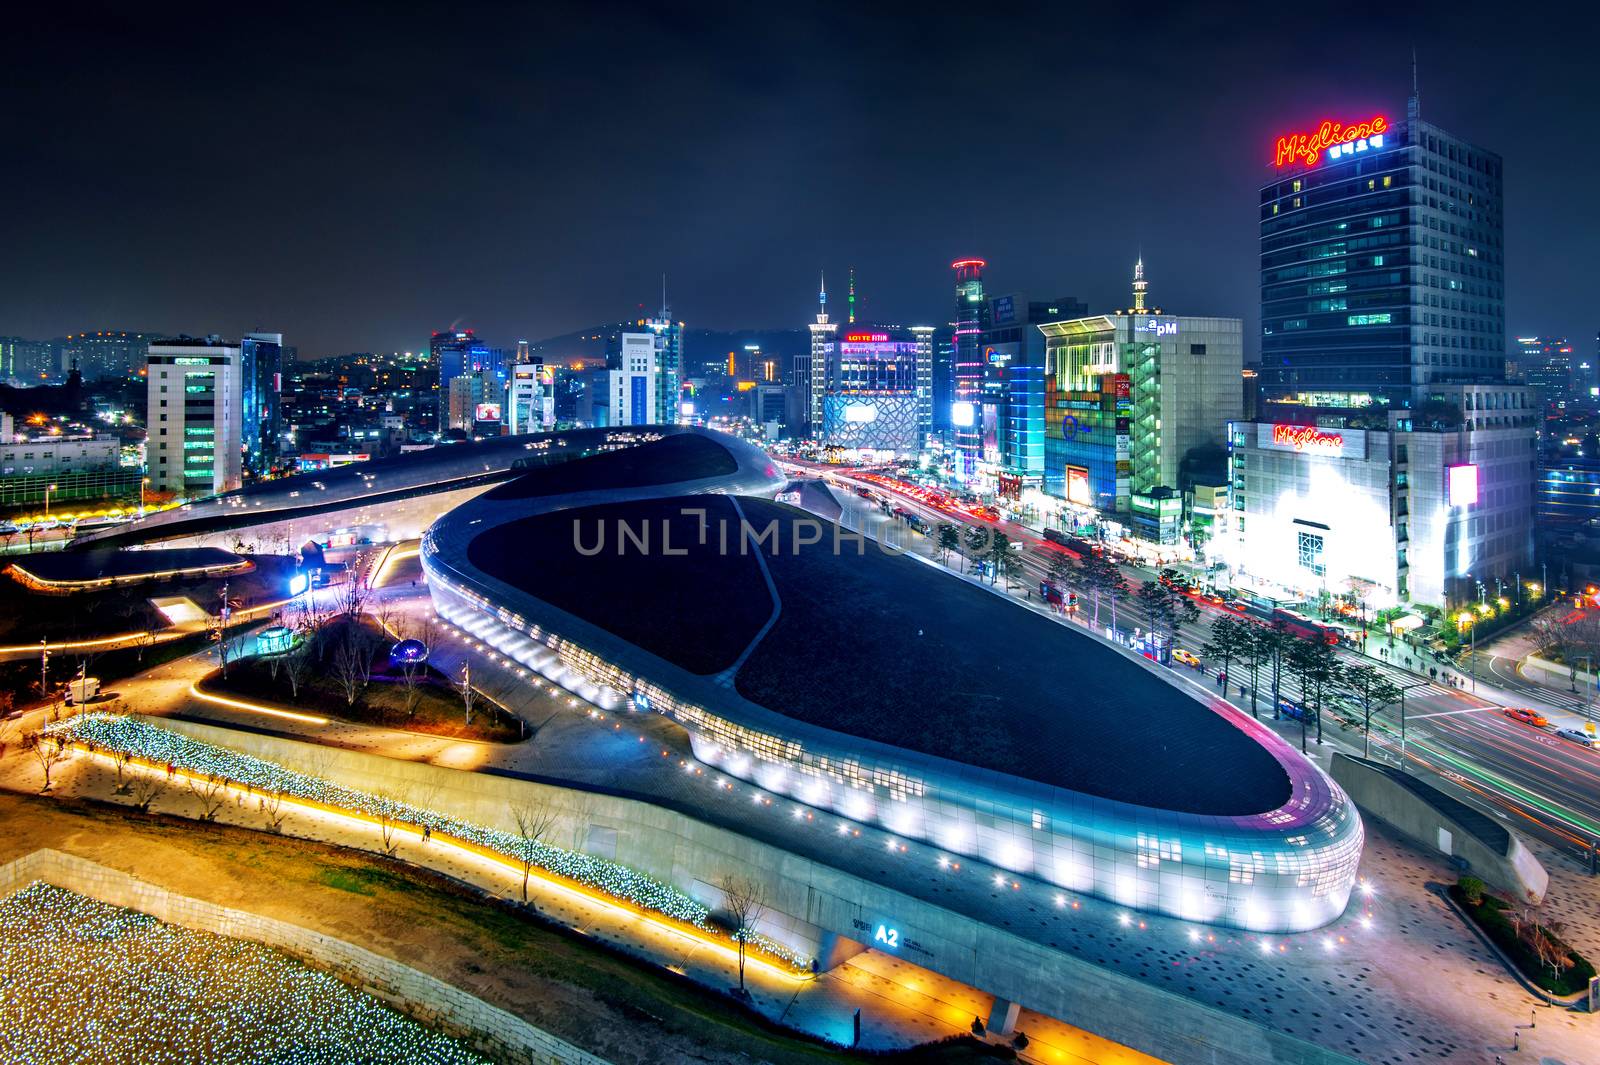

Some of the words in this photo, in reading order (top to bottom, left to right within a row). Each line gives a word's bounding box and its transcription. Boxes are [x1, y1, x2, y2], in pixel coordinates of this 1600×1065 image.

[1276, 117, 1387, 166] Migliore
[1274, 424, 1343, 450] Migliore
[875, 924, 898, 948] A2
